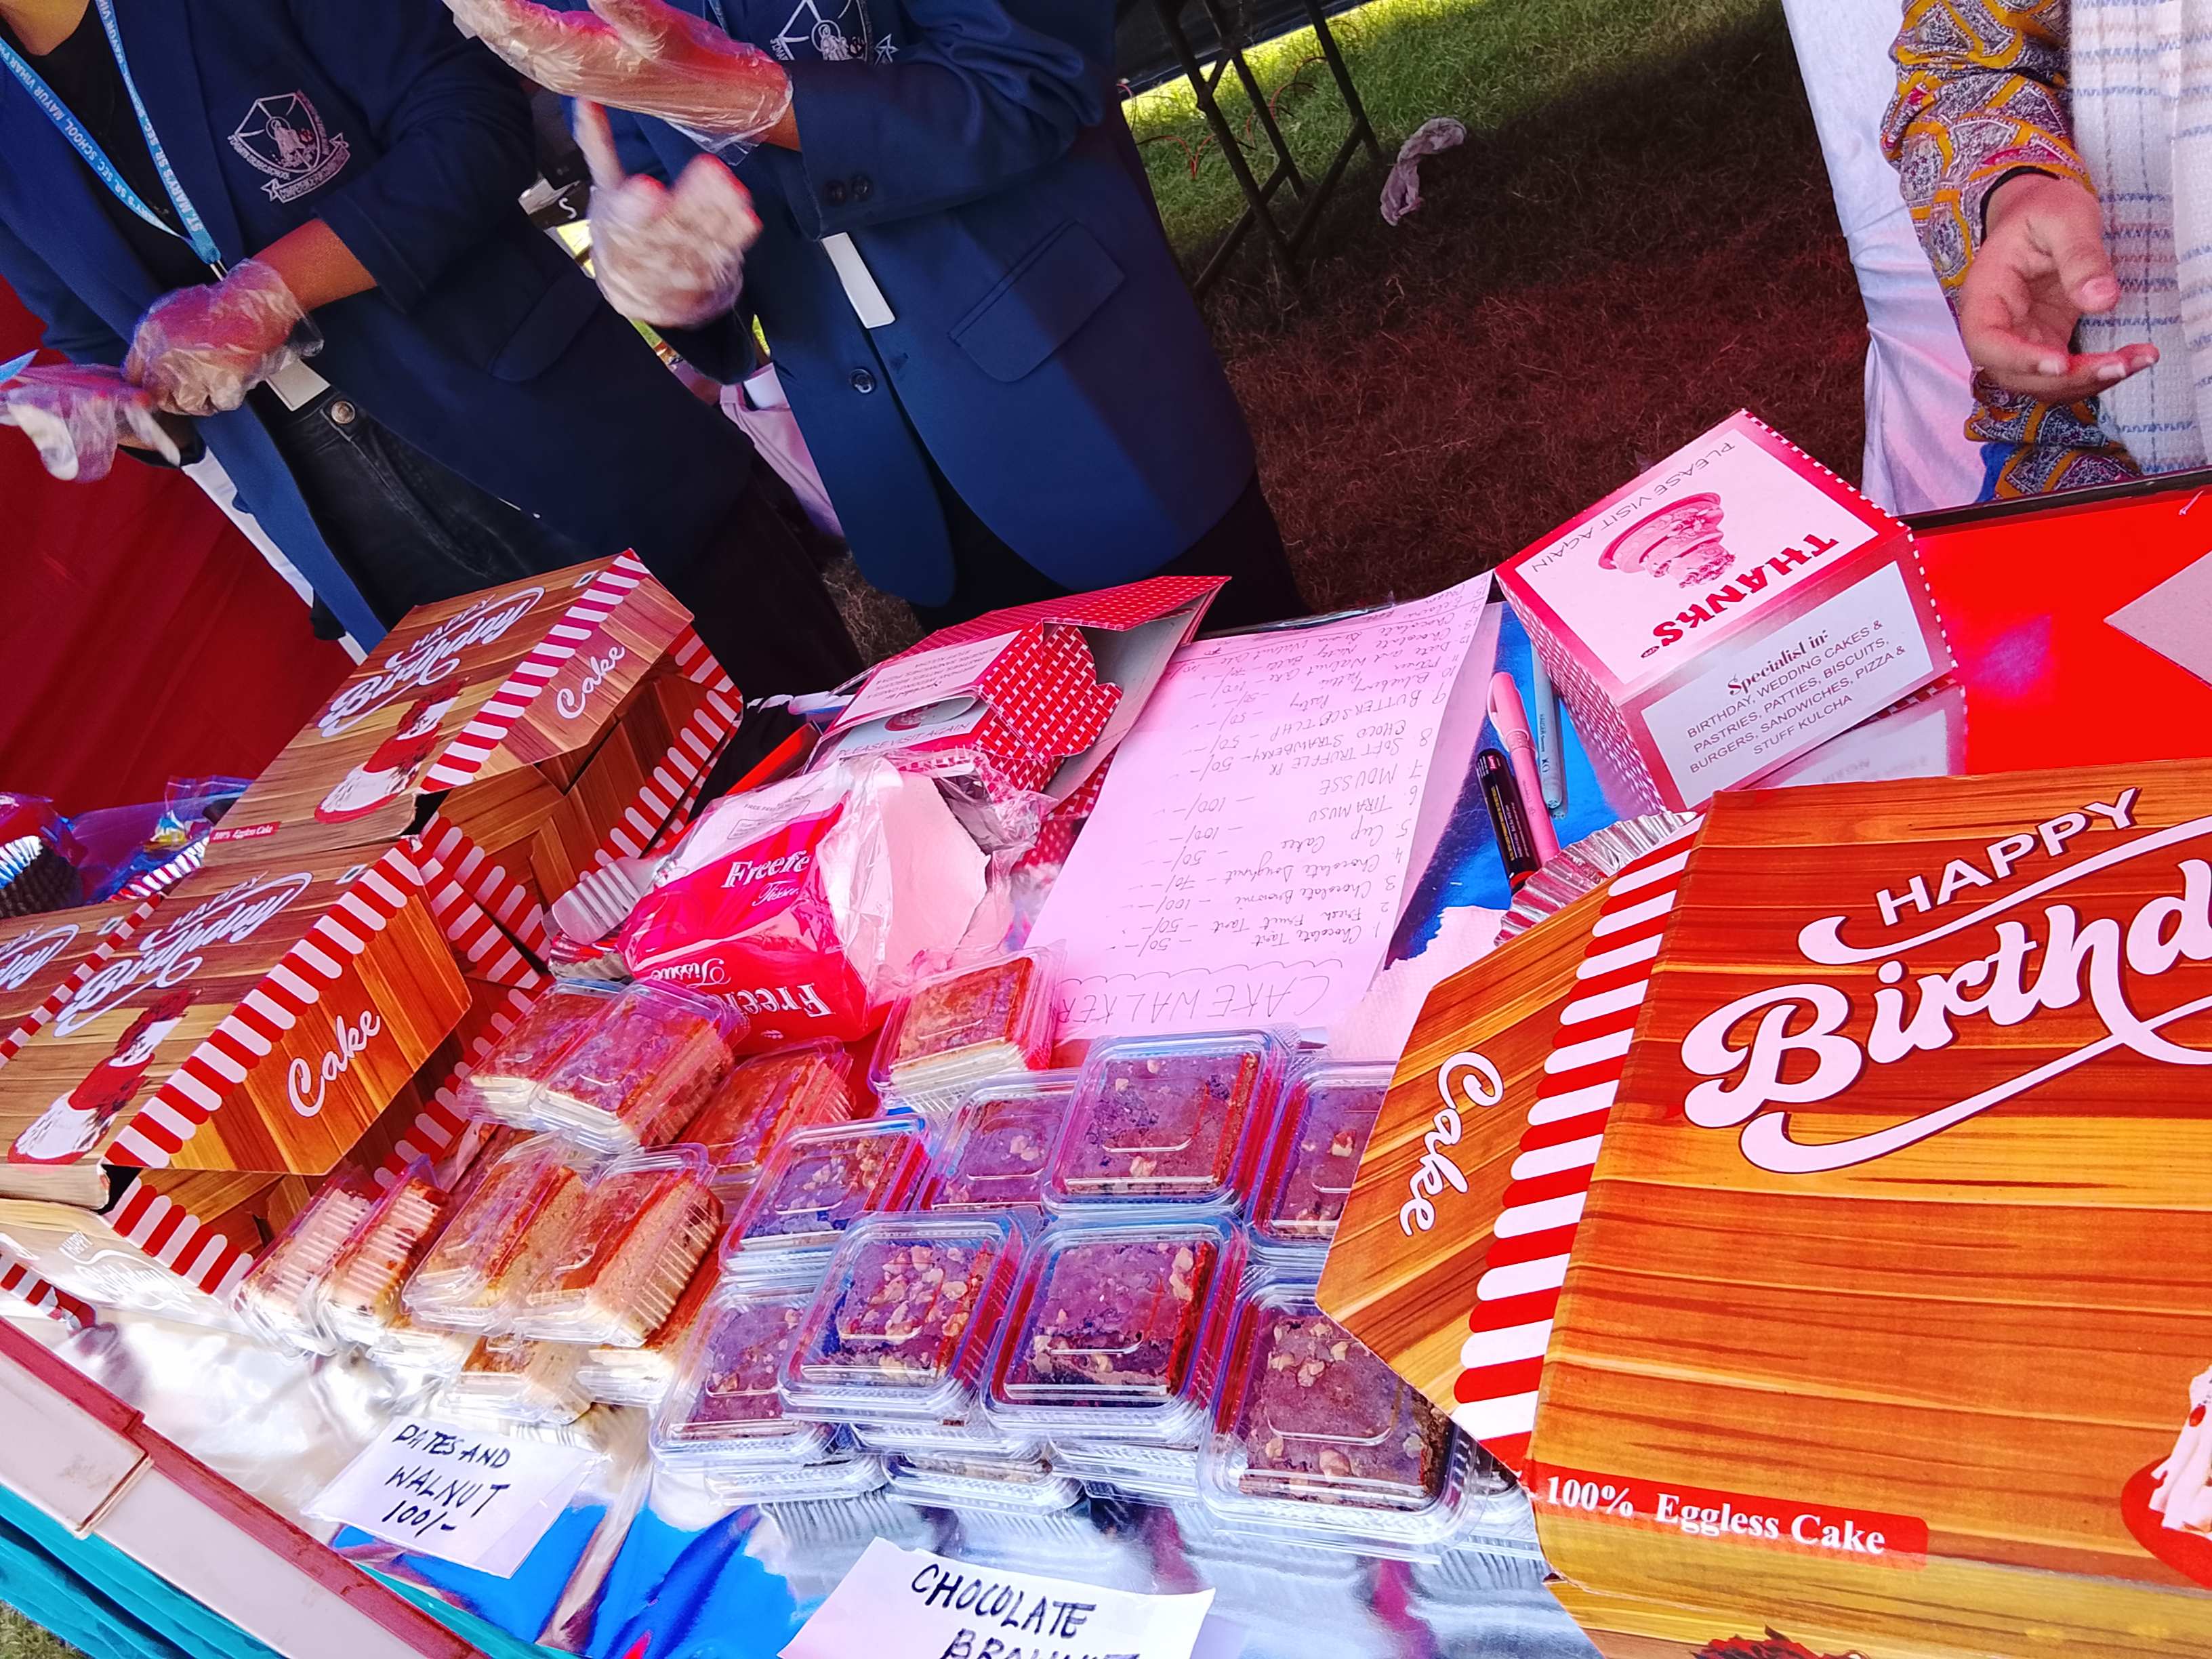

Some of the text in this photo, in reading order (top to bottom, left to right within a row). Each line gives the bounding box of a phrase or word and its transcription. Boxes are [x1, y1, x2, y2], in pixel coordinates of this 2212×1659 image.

[9, 57, 36, 89] VIHAR
[34, 85, 65, 121] MAYUR
[65, 118, 98, 161] SCHOOL,
[98, 158, 114, 182] SEC.
[163, 169, 196, 216] MARY'S
[1532, 442, 1736, 573] PLEASE VISIT AGAIN
[1653, 534, 1839, 647] THANKS
[409, 593, 497, 653] HAPPY
[317, 591, 543, 736] Birthday
[555, 644, 626, 720] Cake
[1727, 640, 1807, 696] Specialist
[1757, 655, 1822, 697] WEDDING
[1824, 627, 1870, 659] CAKES
[1872, 619, 1883, 631] &
[1855, 652, 1895, 680] PIZZA
[1896, 645, 1906, 656] &
[1360, 738, 1400, 759] SOFT
[1753, 694, 1853, 755] STUFF KULCHA
[1292, 746, 1356, 770] TRUFFLE
[1319, 763, 1398, 796] MOUSSE
[1351, 816, 1384, 846] Cup
[1876, 787, 2143, 927] HAPPY
[1300, 881, 1372, 899] Chocolate
[1303, 855, 1380, 877] Chocolate
[167, 871, 269, 933] HAPPY
[54, 872, 314, 1037] Birthday
[286, 1008, 382, 1118] Cake
[1397, 1050, 1504, 1237] Cake
[392, 1423, 511, 1470] DATES AND
[381, 1500, 457, 1538] 100/-
[384, 1465, 511, 1519] WALNUT
[1547, 1475, 1887, 1555] 100% Eggless Cake
[911, 1563, 1098, 1639] CHOCOLATE
